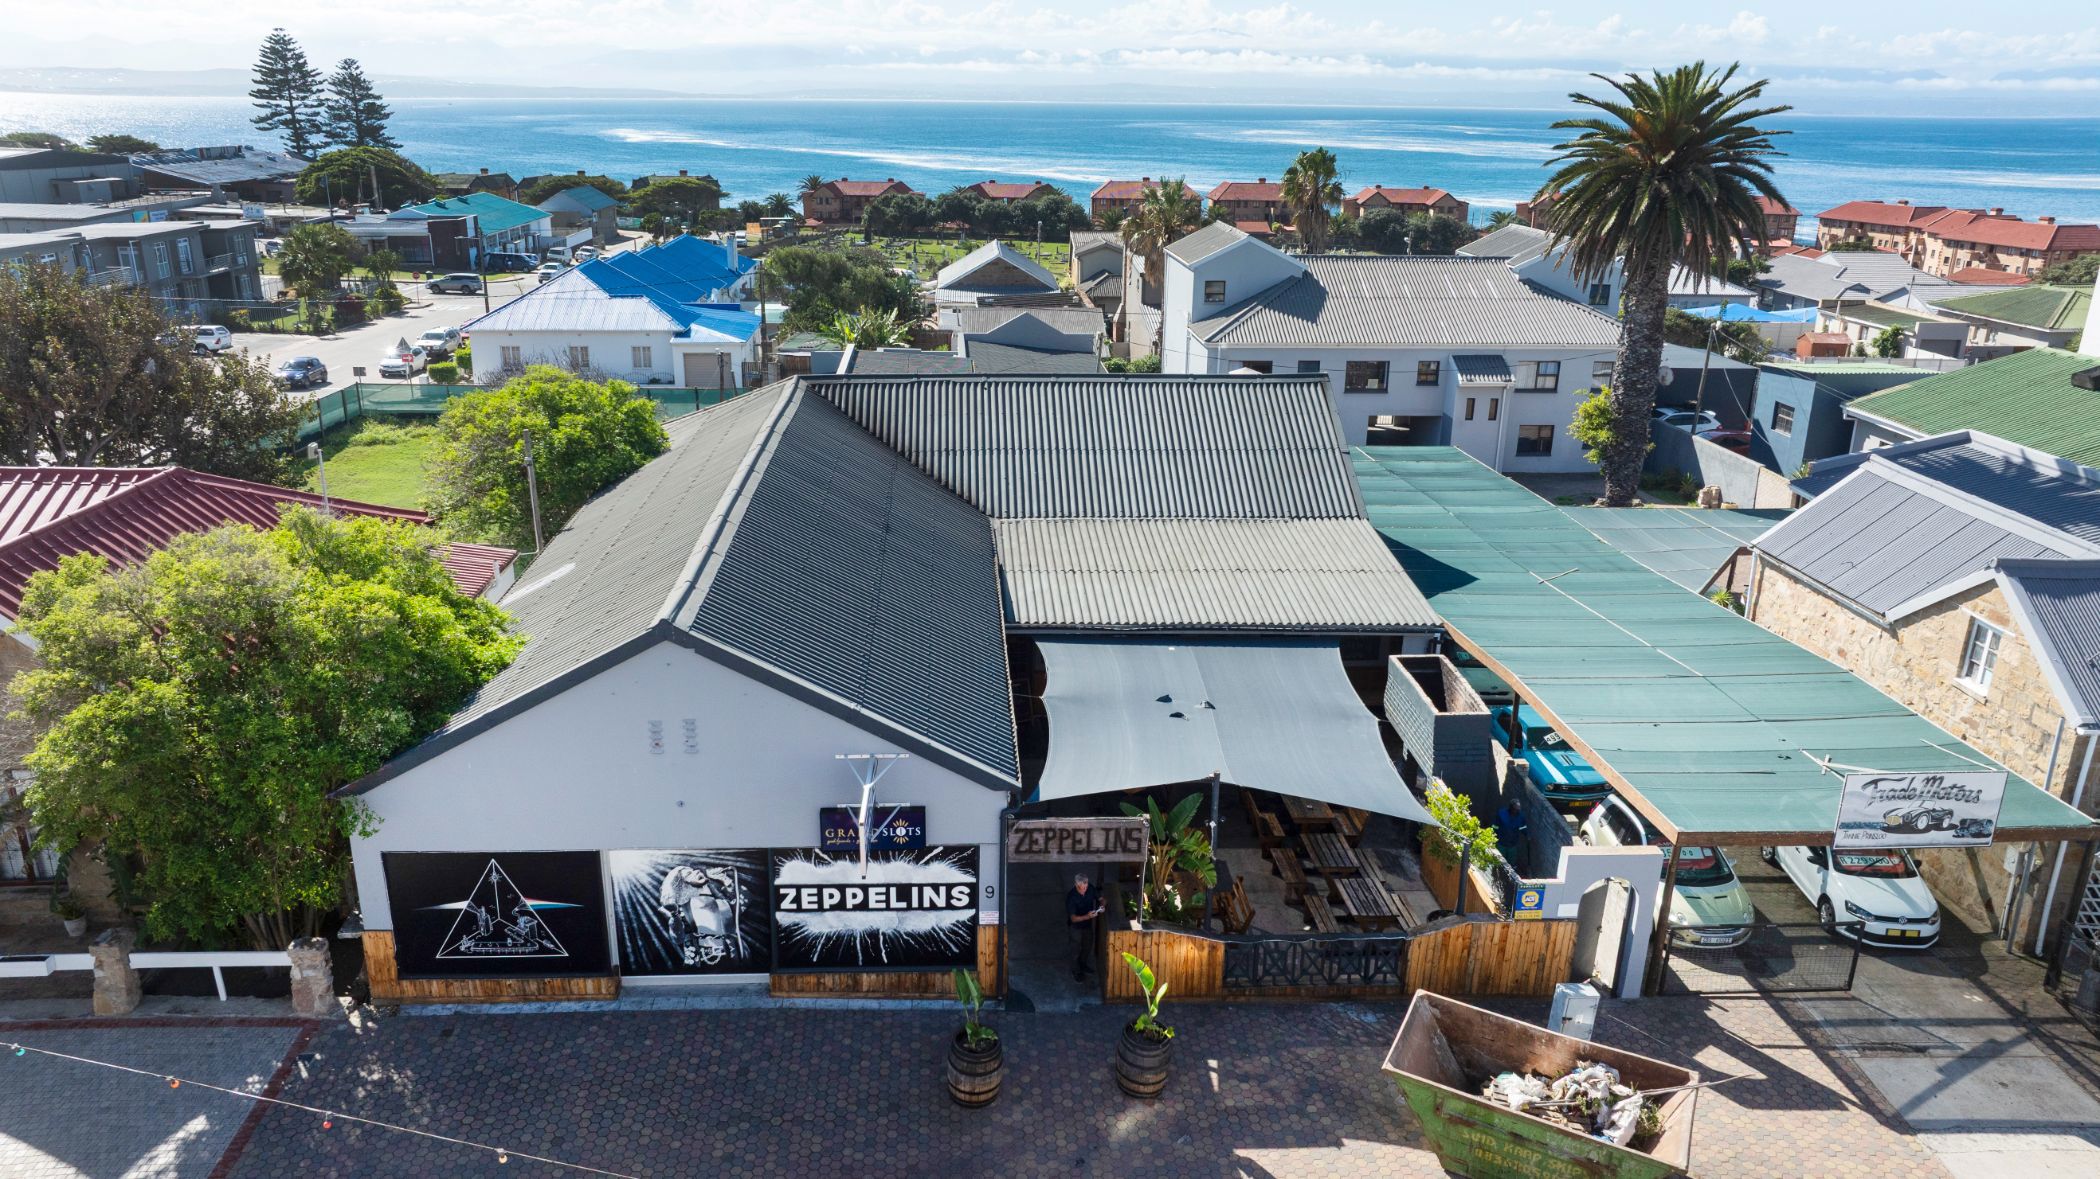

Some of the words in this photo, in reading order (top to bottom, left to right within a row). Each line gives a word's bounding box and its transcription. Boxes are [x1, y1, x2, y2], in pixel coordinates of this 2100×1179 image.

[1861, 776, 1917, 808] Trade
[1918, 775, 1983, 804] Motors
[825, 828, 878, 838] GRAD
[1014, 827, 1143, 855] ZEPPELINS
[779, 885, 971, 910] ZEPPELINS
[984, 885, 995, 899] 9
